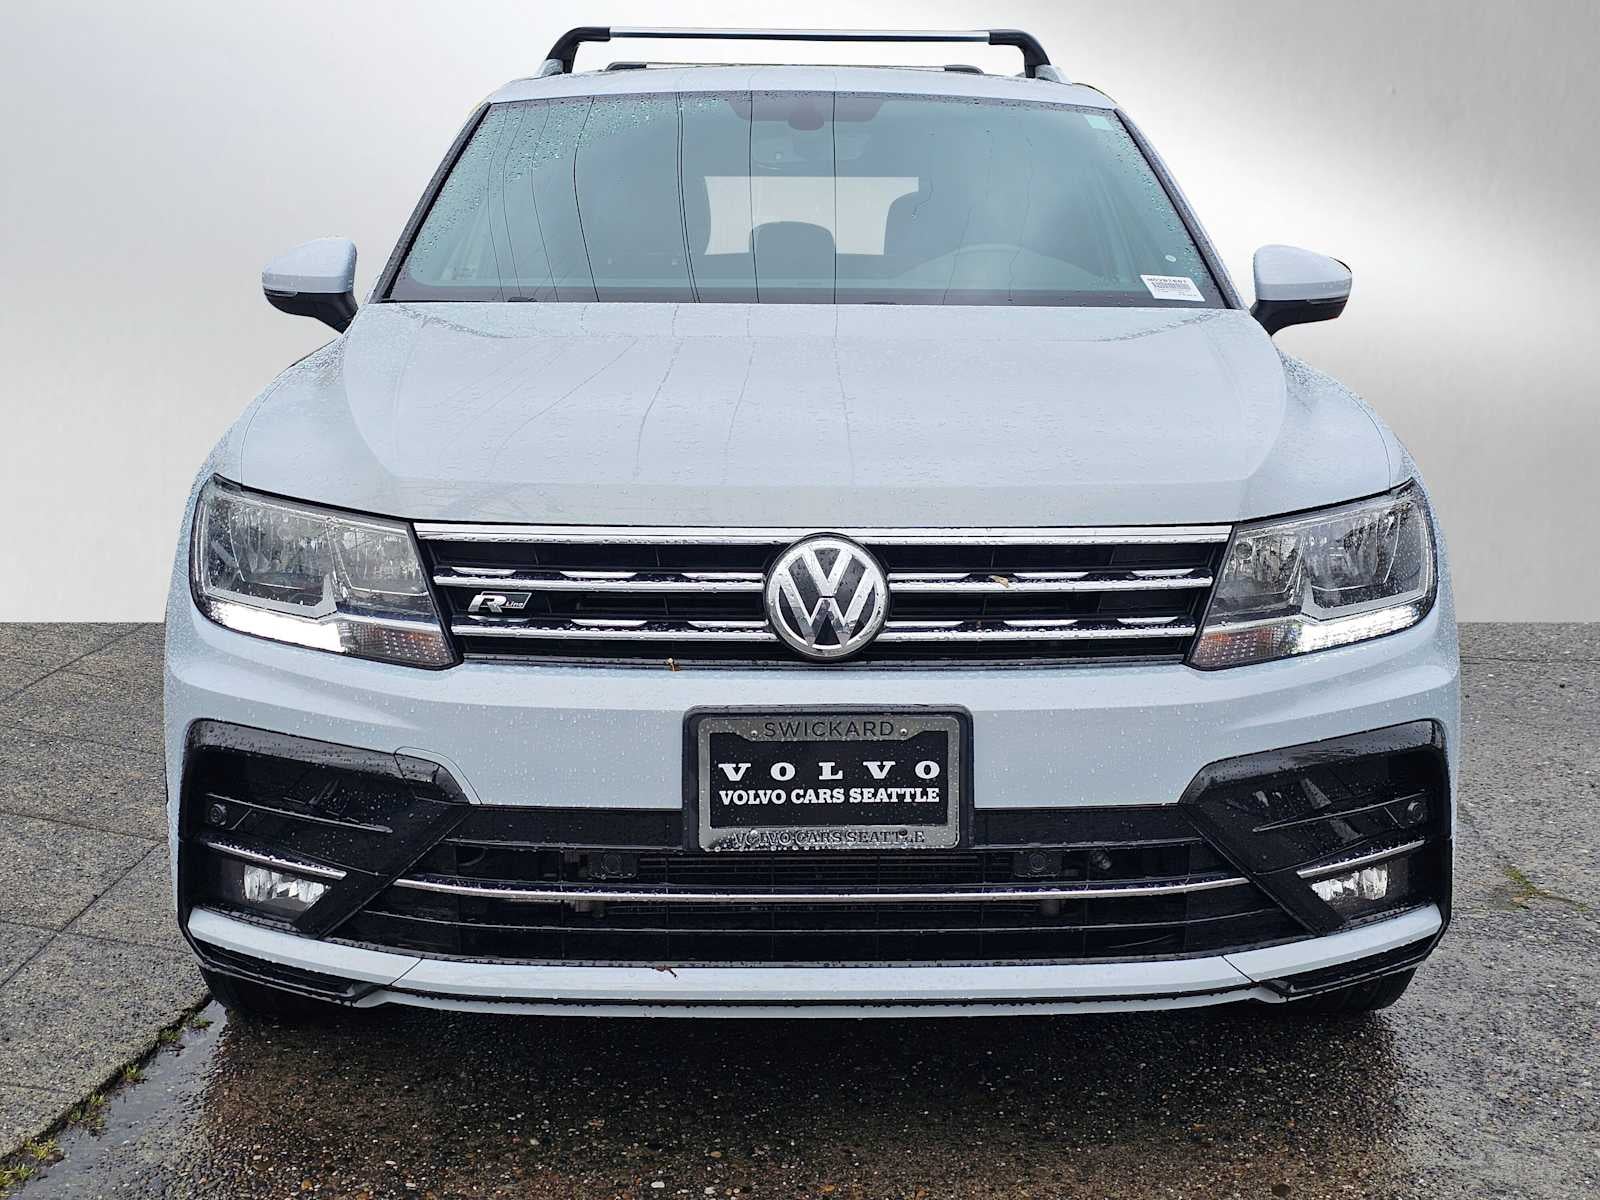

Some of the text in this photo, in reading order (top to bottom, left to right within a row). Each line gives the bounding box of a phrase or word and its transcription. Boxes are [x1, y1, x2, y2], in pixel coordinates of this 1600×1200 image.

[467, 594, 507, 613] R
[771, 539, 882, 651] VW
[764, 721, 894, 737] SWICKARD
[718, 760, 940, 781] VOLVO
[719, 787, 940, 805] VOLVO CARS SEATTLE
[795, 830, 842, 844] CARS
